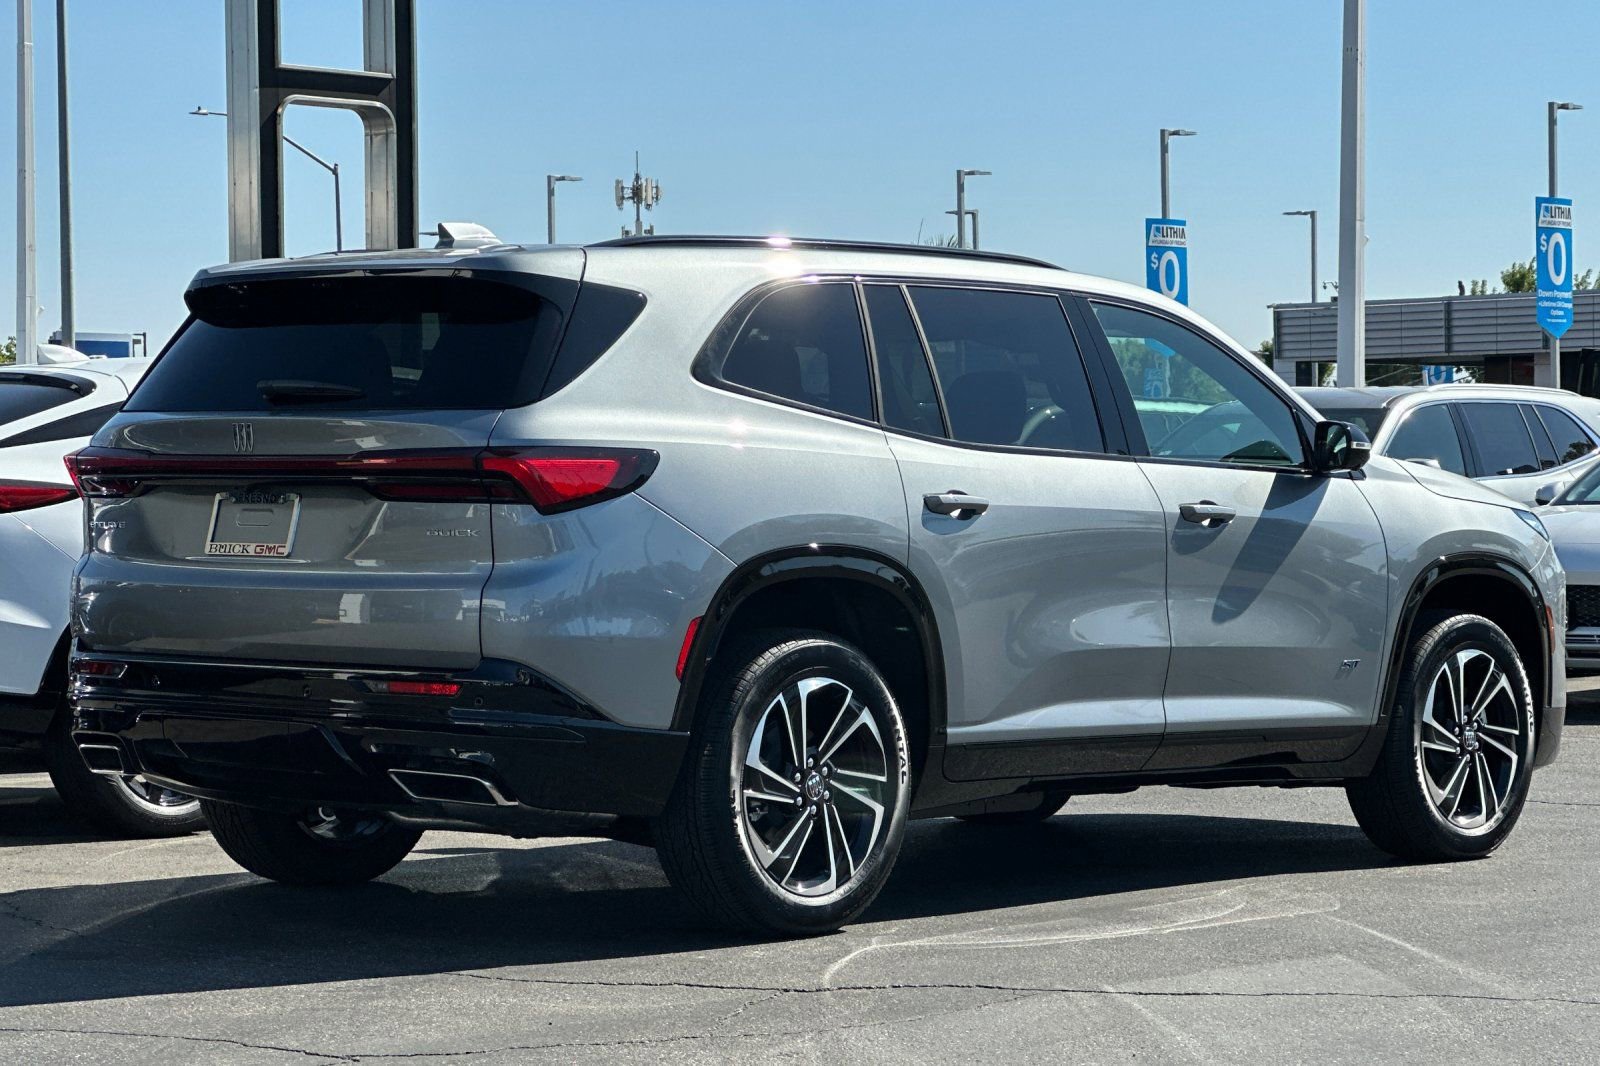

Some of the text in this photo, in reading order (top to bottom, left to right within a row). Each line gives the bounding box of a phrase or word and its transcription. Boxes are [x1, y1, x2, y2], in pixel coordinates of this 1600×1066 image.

[1550, 205, 1572, 220] LITHIA
[1161, 226, 1186, 240] LITHIA
[1540, 232, 1567, 286] $0
[1151, 250, 1180, 300] $0
[1538, 289, 1553, 298] Down
[425, 528, 480, 537] BUICK
[208, 543, 287, 555] BUICK GMC
